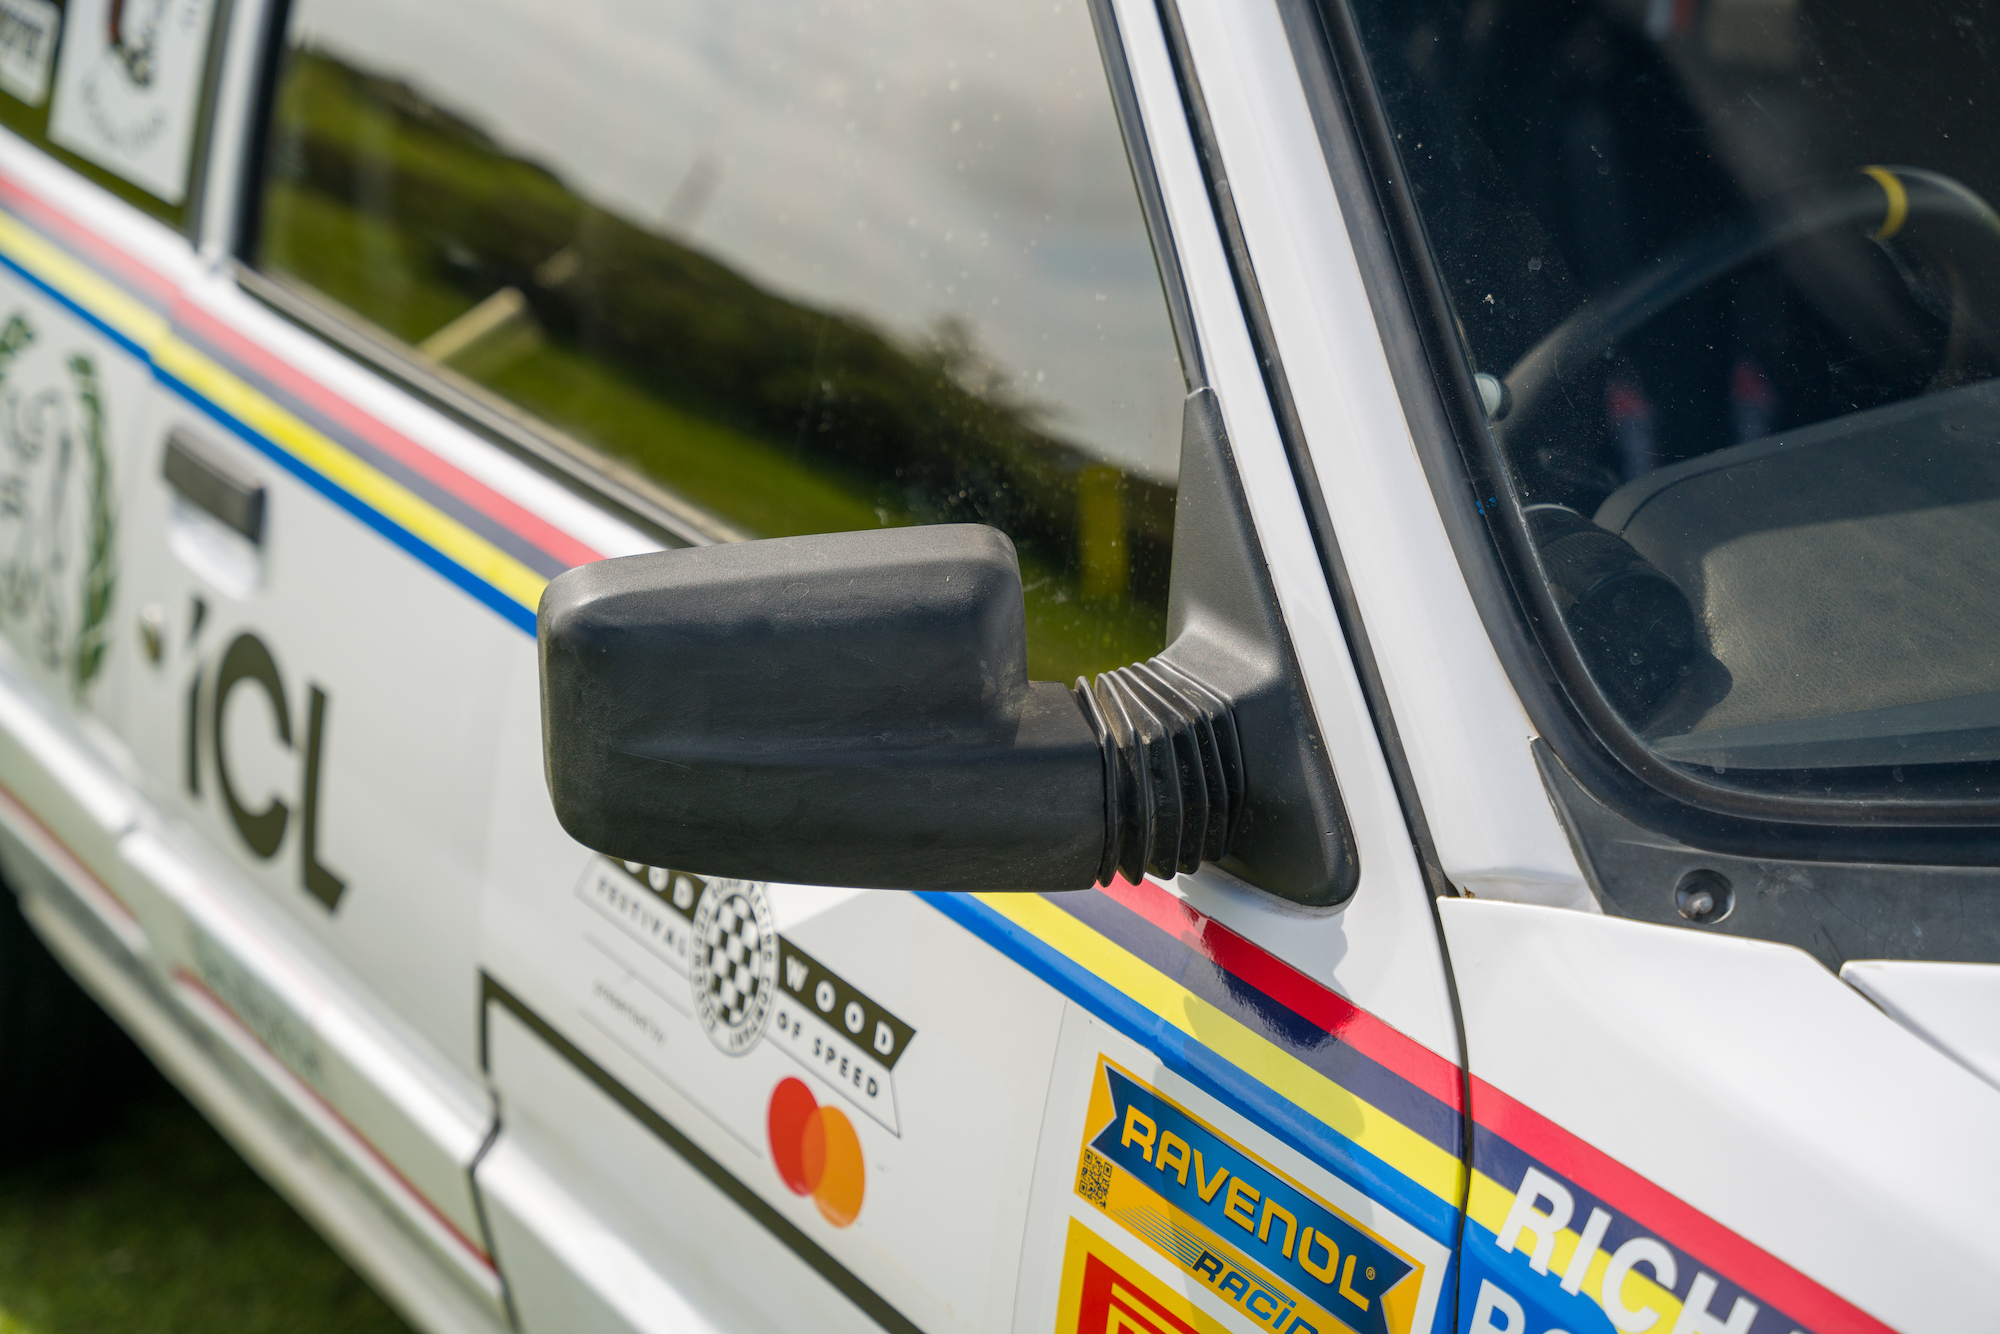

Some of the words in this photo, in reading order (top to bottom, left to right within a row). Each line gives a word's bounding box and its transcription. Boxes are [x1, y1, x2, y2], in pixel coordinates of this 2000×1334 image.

[746, 881, 774, 963] RACING
[596, 876, 687, 957] FESTIVAL
[777, 1011, 801, 1039] OF
[812, 1036, 878, 1098] SPEED
[728, 975, 771, 1048] COMPANY
[785, 954, 896, 1056] WOOD
[1495, 1165, 1812, 1334] RICH
